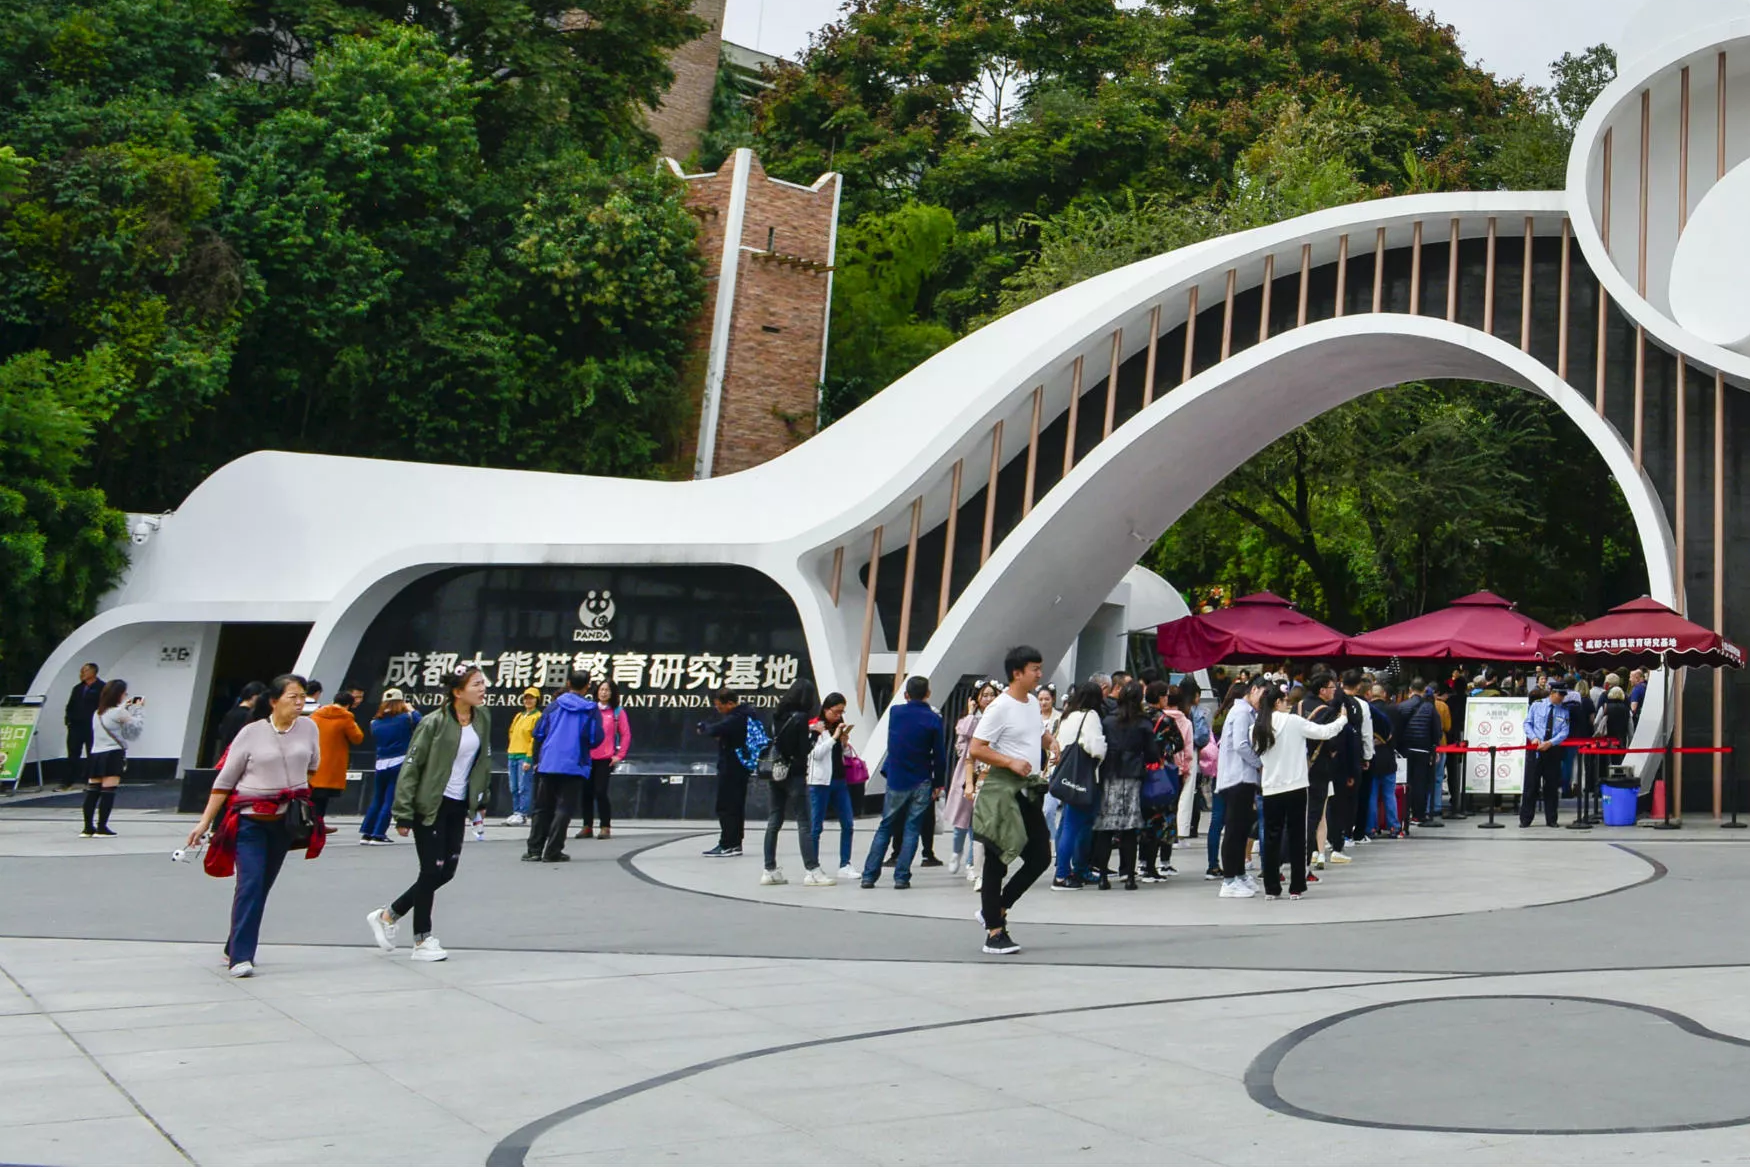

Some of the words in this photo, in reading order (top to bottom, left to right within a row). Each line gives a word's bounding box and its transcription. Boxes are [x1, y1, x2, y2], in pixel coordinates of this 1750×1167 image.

[573, 629, 612, 642] PANDA
[384, 650, 798, 690] 成都大熊猫繁育研究基地
[619, 694, 656, 707] IANT
[659, 694, 711, 708] PANDA
